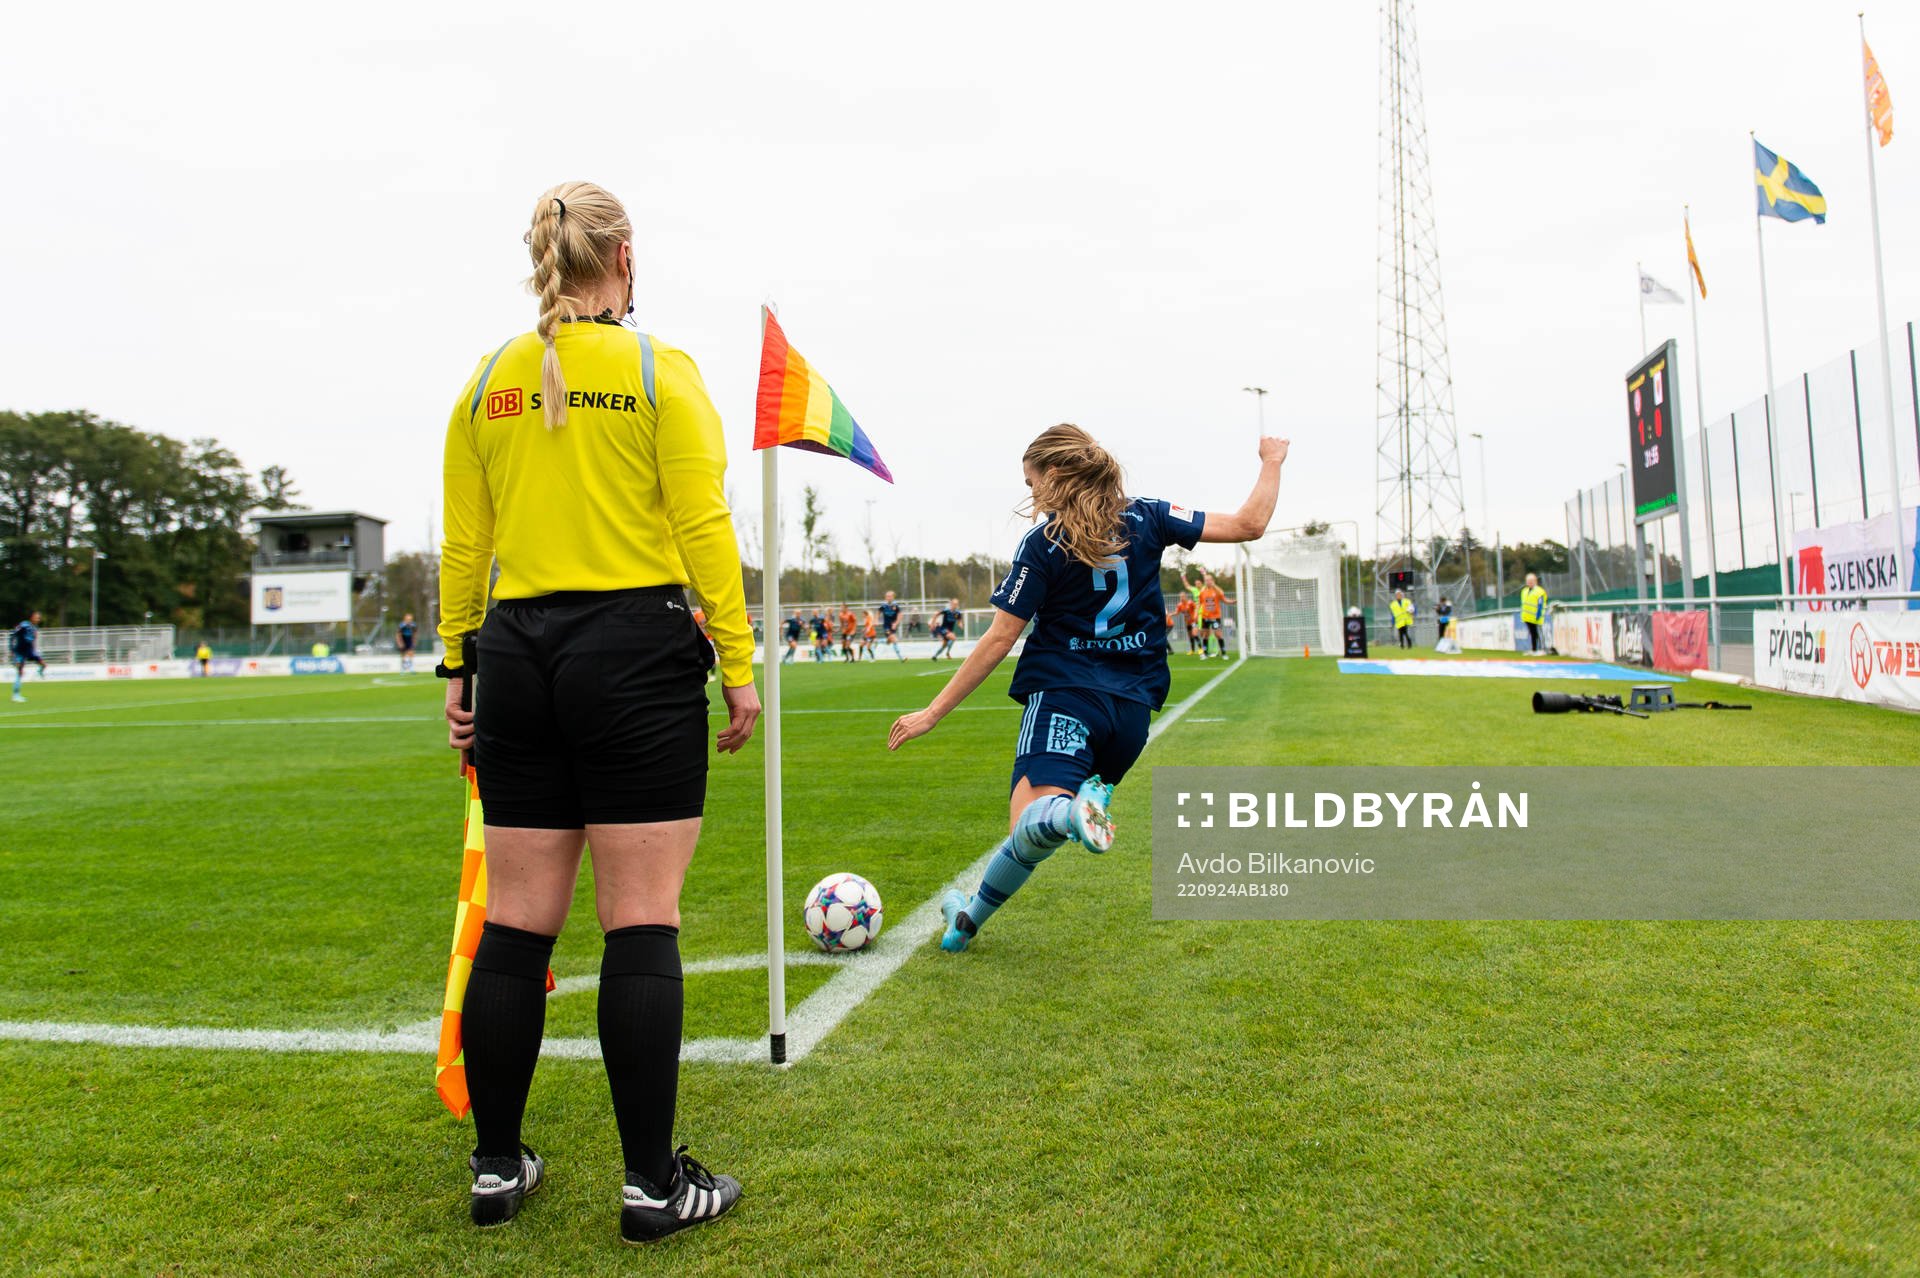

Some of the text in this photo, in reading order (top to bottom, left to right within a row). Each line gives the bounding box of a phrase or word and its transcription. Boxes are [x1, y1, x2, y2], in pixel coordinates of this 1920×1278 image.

[491, 391, 637, 415] DB SENKER
[1008, 566, 1029, 606] stadium
[1828, 553, 1899, 592] SVENSKA
[1092, 554, 1131, 639] 2
[1769, 619, 1814, 666] privab
